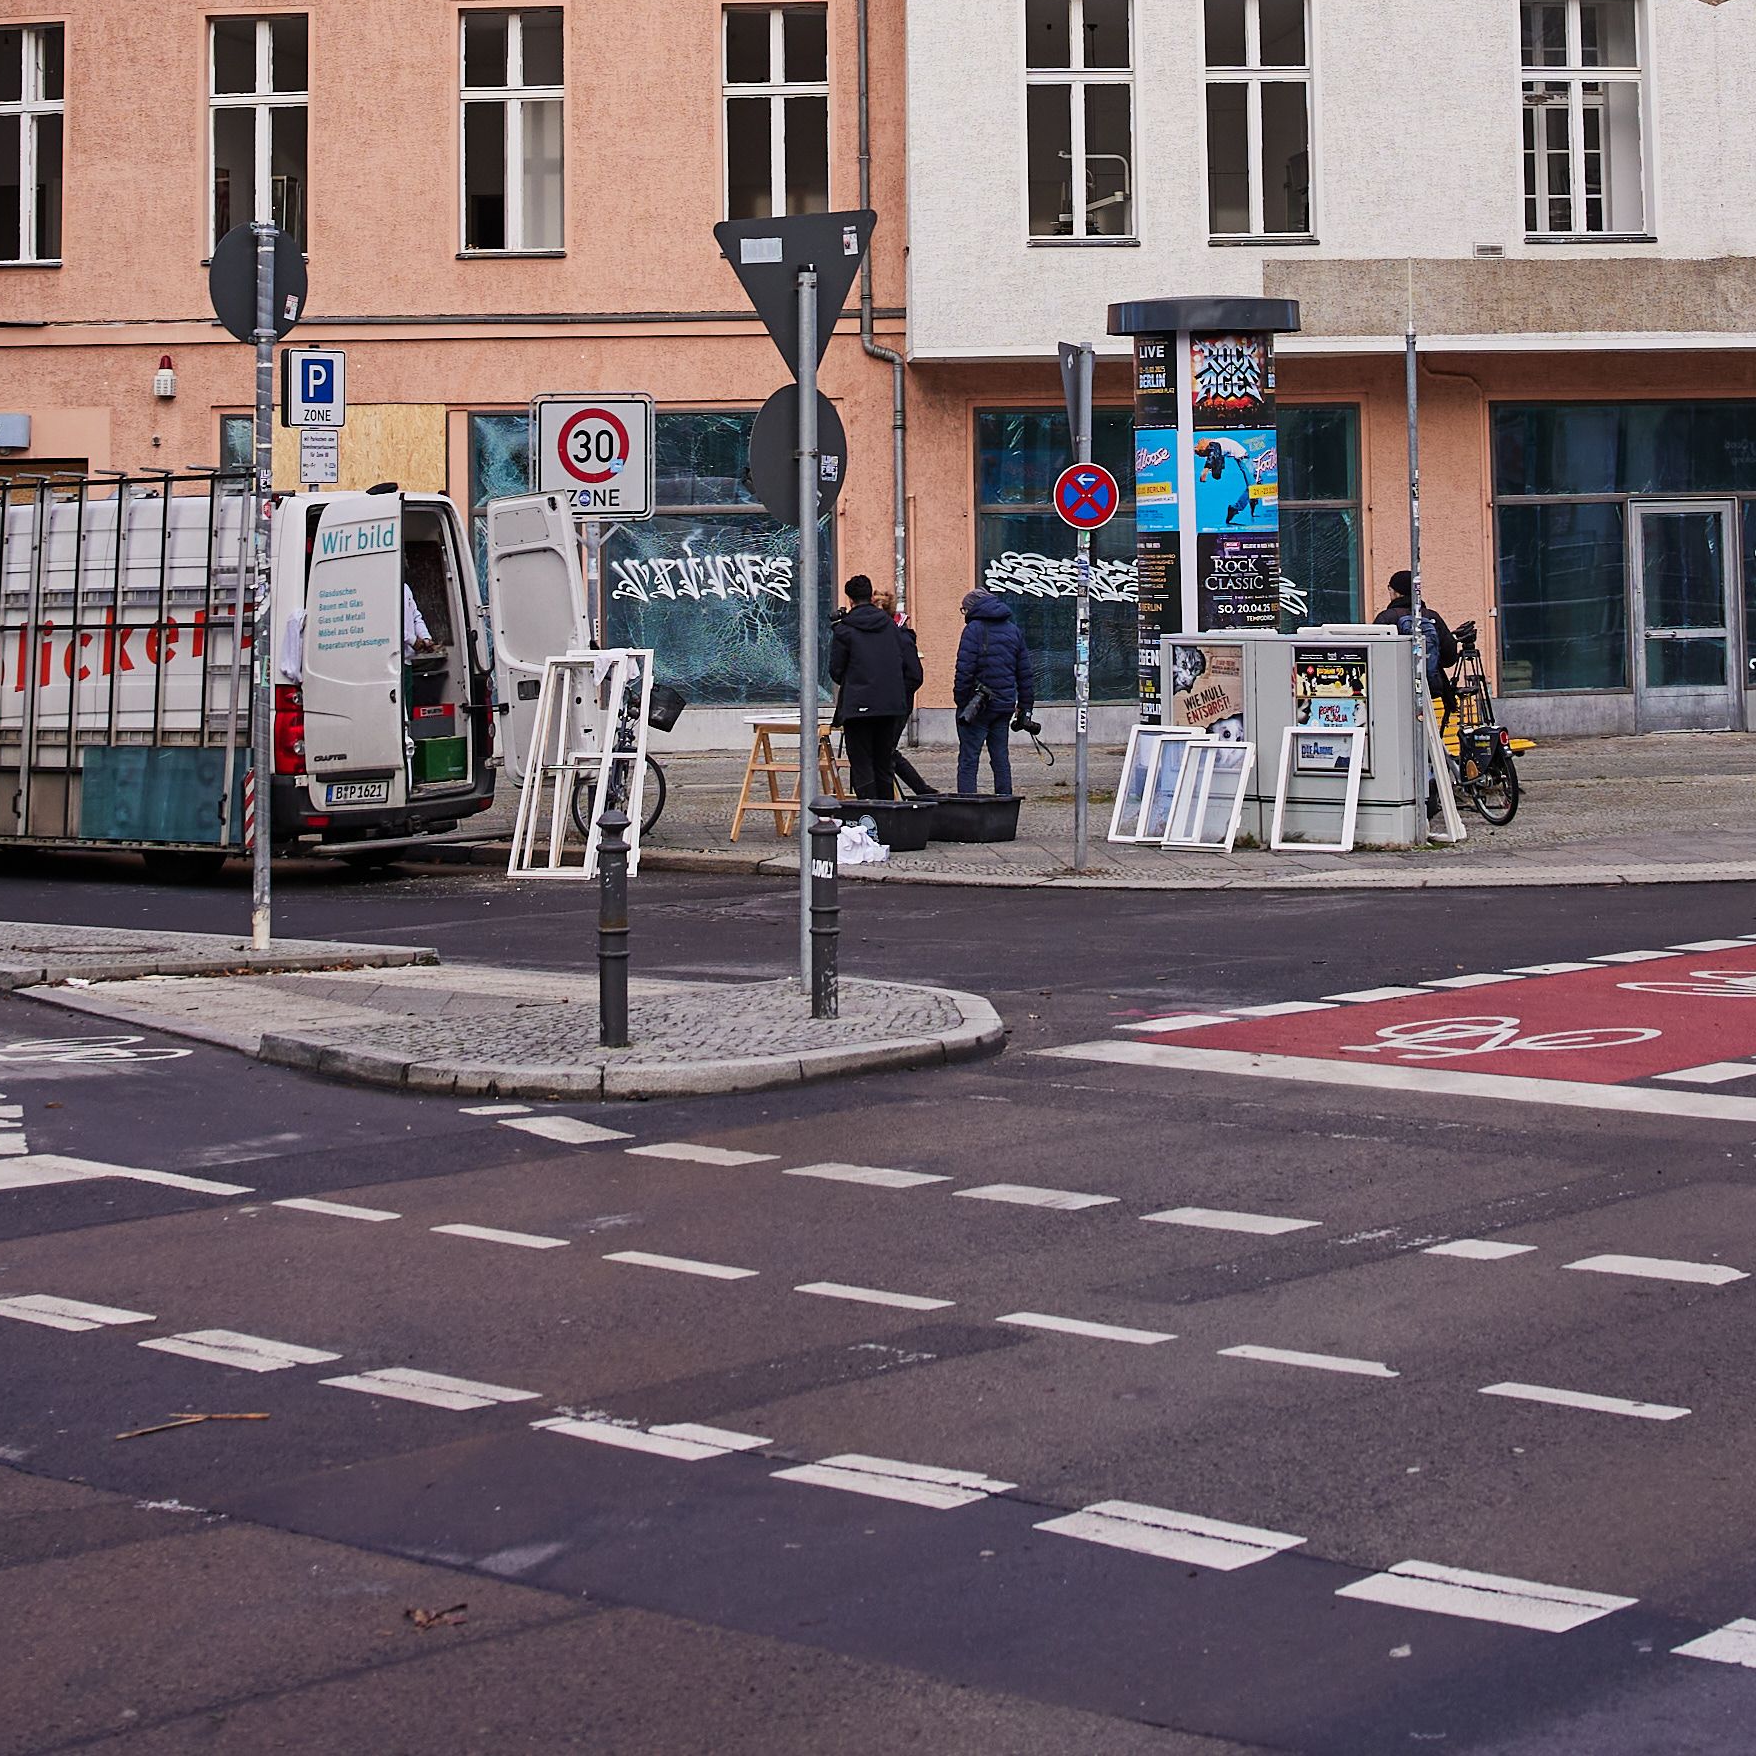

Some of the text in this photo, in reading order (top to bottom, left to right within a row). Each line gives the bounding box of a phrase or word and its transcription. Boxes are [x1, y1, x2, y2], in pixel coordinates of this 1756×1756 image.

[1139, 345, 1165, 358] LIVE
[1194, 340, 1261, 378] ROCK
[308, 364, 327, 398] P
[1195, 369, 1264, 404] AGES
[304, 409, 332, 422] ZONE
[572, 429, 614, 463] 30
[322, 523, 395, 554] Wir bild
[1213, 558, 1258, 573] ROCK
[1205, 576, 1264, 590] CLASSIC
[1183, 694, 1201, 711] WIE
[336, 784, 382, 799] B P 1621
